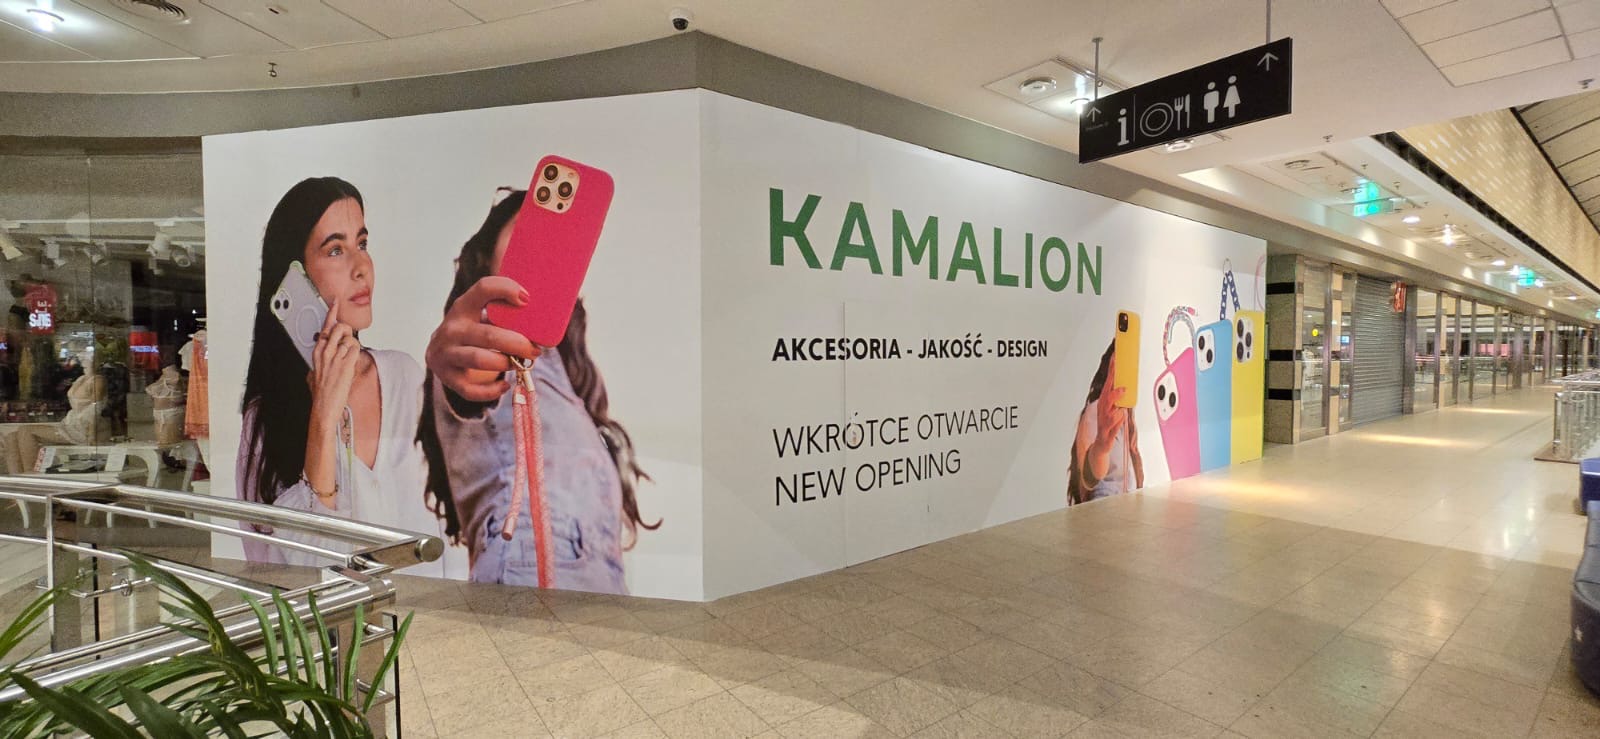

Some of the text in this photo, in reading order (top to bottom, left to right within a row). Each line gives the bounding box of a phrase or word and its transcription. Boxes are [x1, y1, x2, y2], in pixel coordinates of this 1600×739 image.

[769, 187, 1103, 296] KAMALION
[772, 337, 902, 362] AKCESORIA
[917, 333, 983, 360] JAKOŚĆ
[997, 339, 1048, 358] DESIGN
[772, 405, 1019, 458] WKRÓTCE OTWARCIE
[775, 449, 962, 507] NEW OPENING
